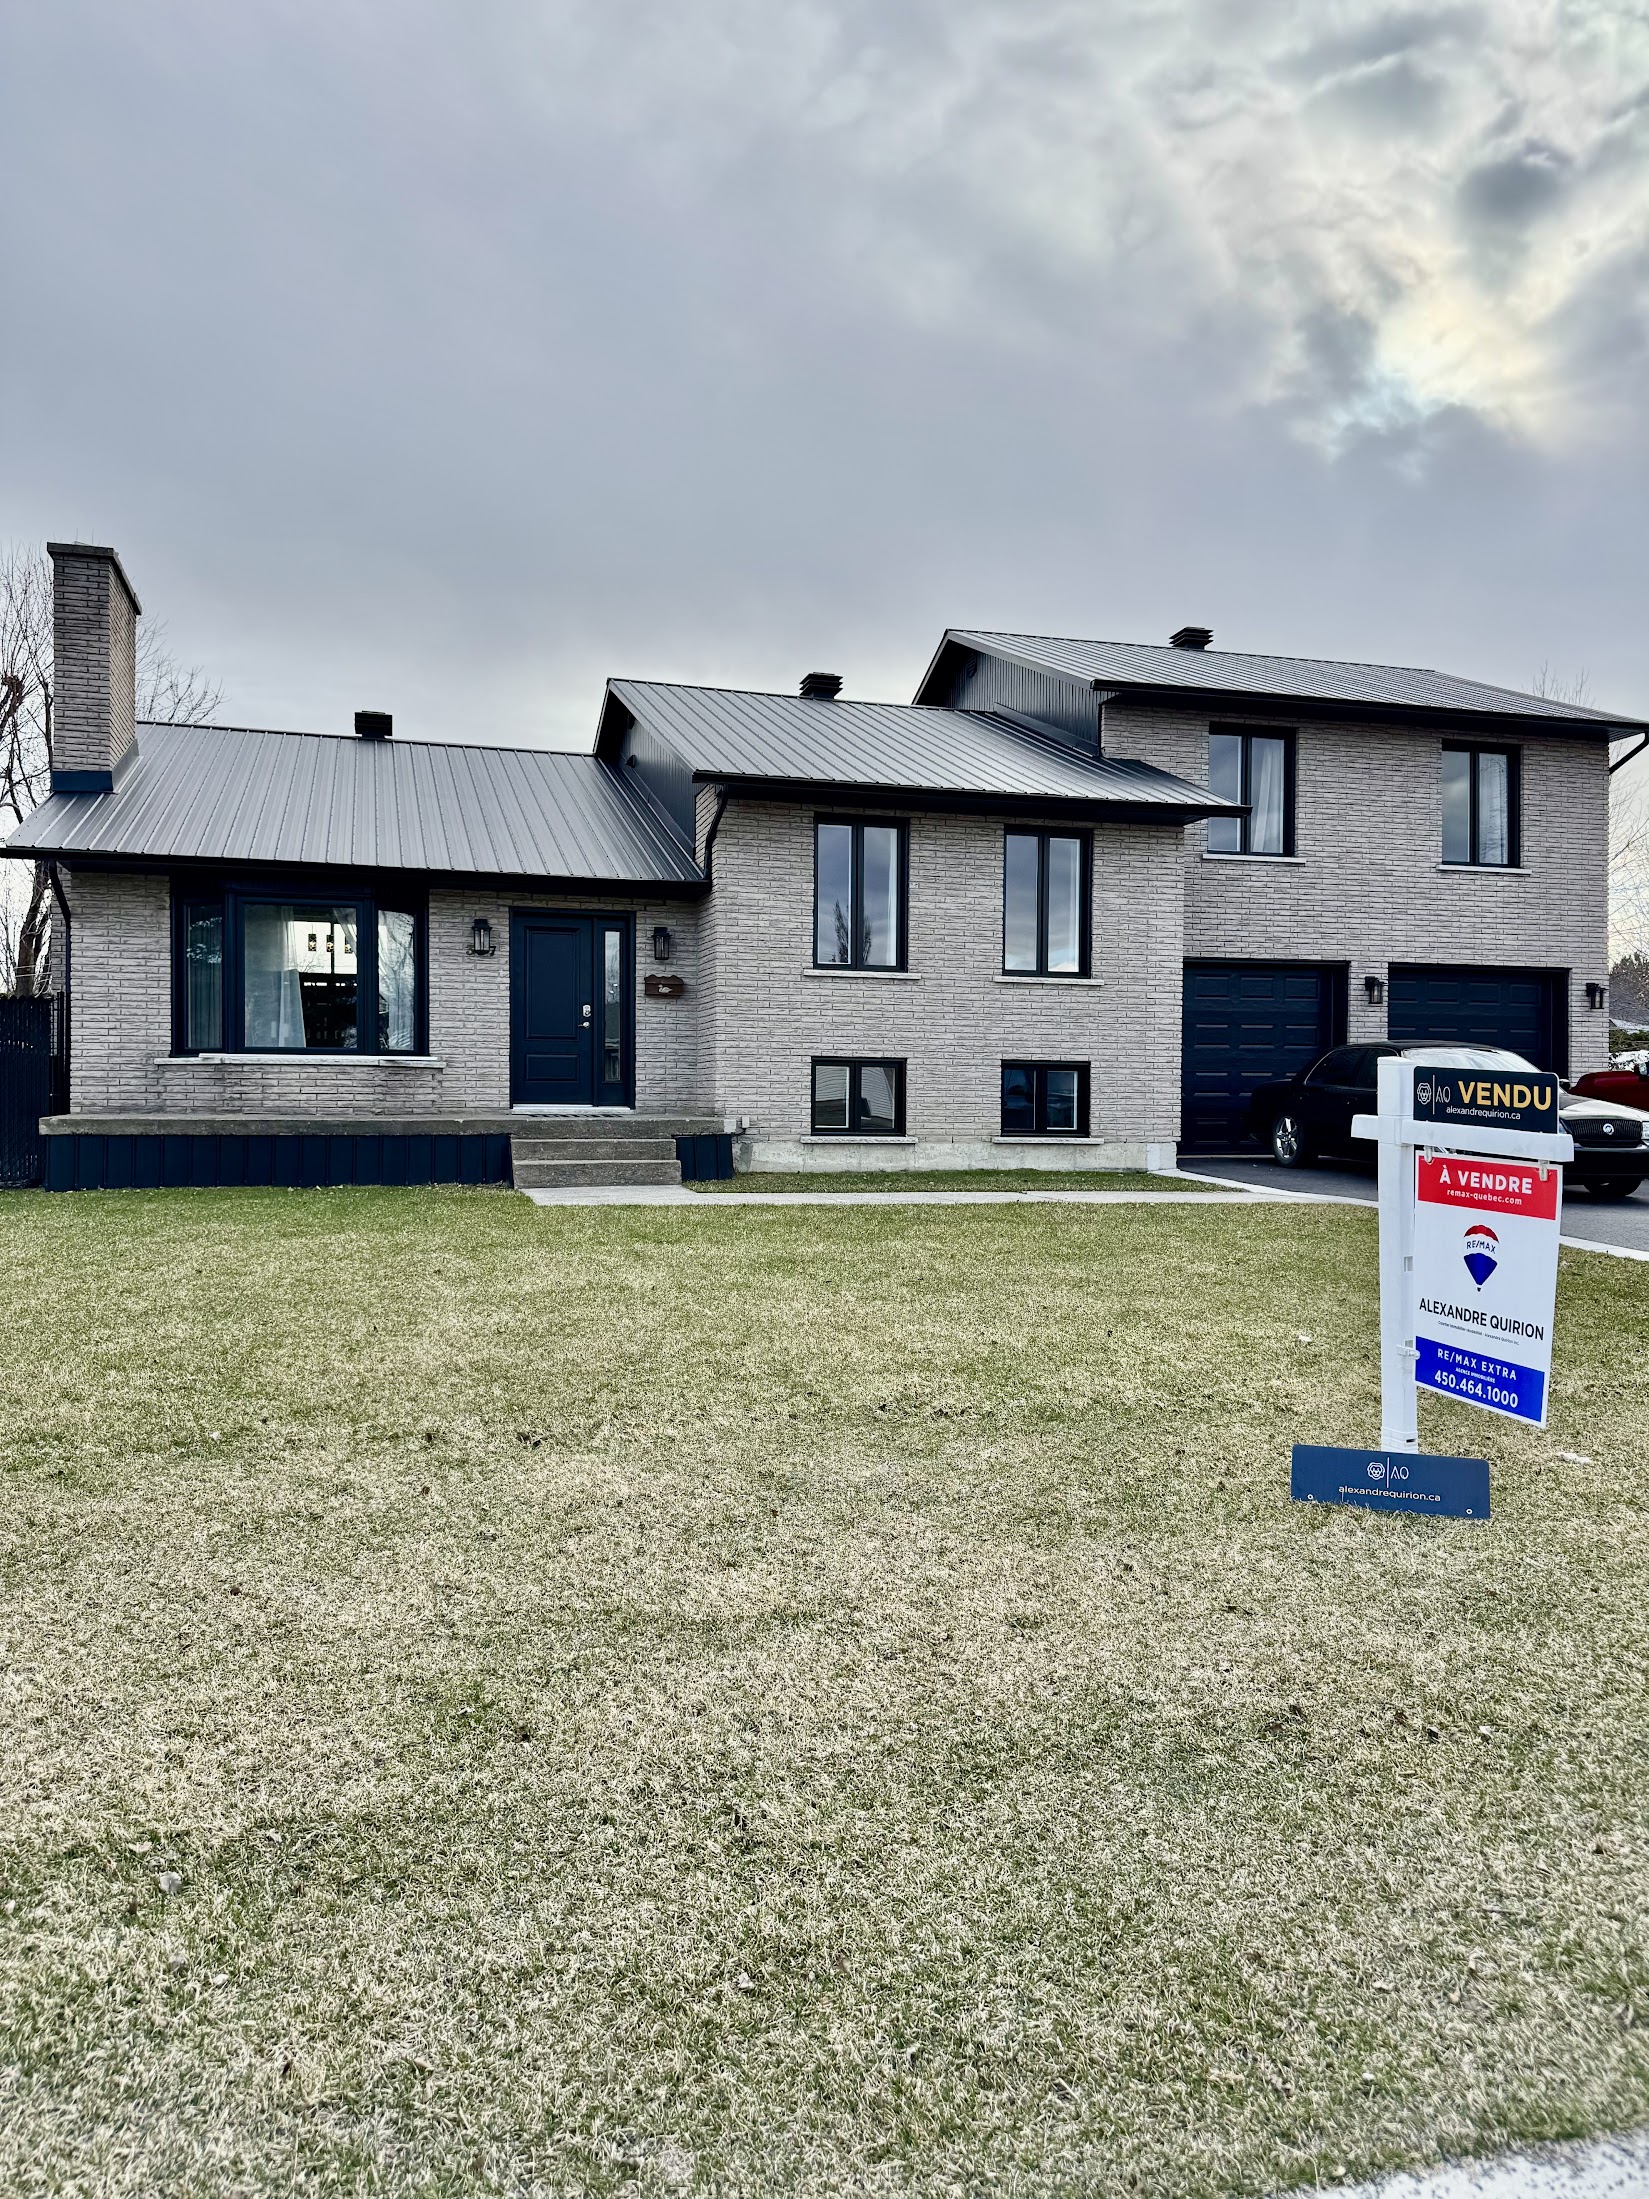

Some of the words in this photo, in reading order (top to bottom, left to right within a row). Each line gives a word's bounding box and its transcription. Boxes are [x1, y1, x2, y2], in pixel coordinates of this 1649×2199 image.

[1458, 1080, 1552, 1111] VENDU
[1446, 1106, 1521, 1120] alexandrequirion.ca
[1439, 1164, 1451, 1185] À
[1457, 1170, 1533, 1195] VENDRE
[1446, 1189, 1522, 1206] remax-quebec.com
[1466, 1239, 1497, 1255] RE/MAX
[1419, 1297, 1488, 1327] ALEXANDRE
[1490, 1315, 1544, 1341] QUIRION
[1437, 1348, 1477, 1369] RE/MAX
[1481, 1361, 1517, 1381] EXTRA
[1434, 1369, 1519, 1409] 450.464.1000
[1338, 1485, 1441, 1502] alexandrequirion.ca
